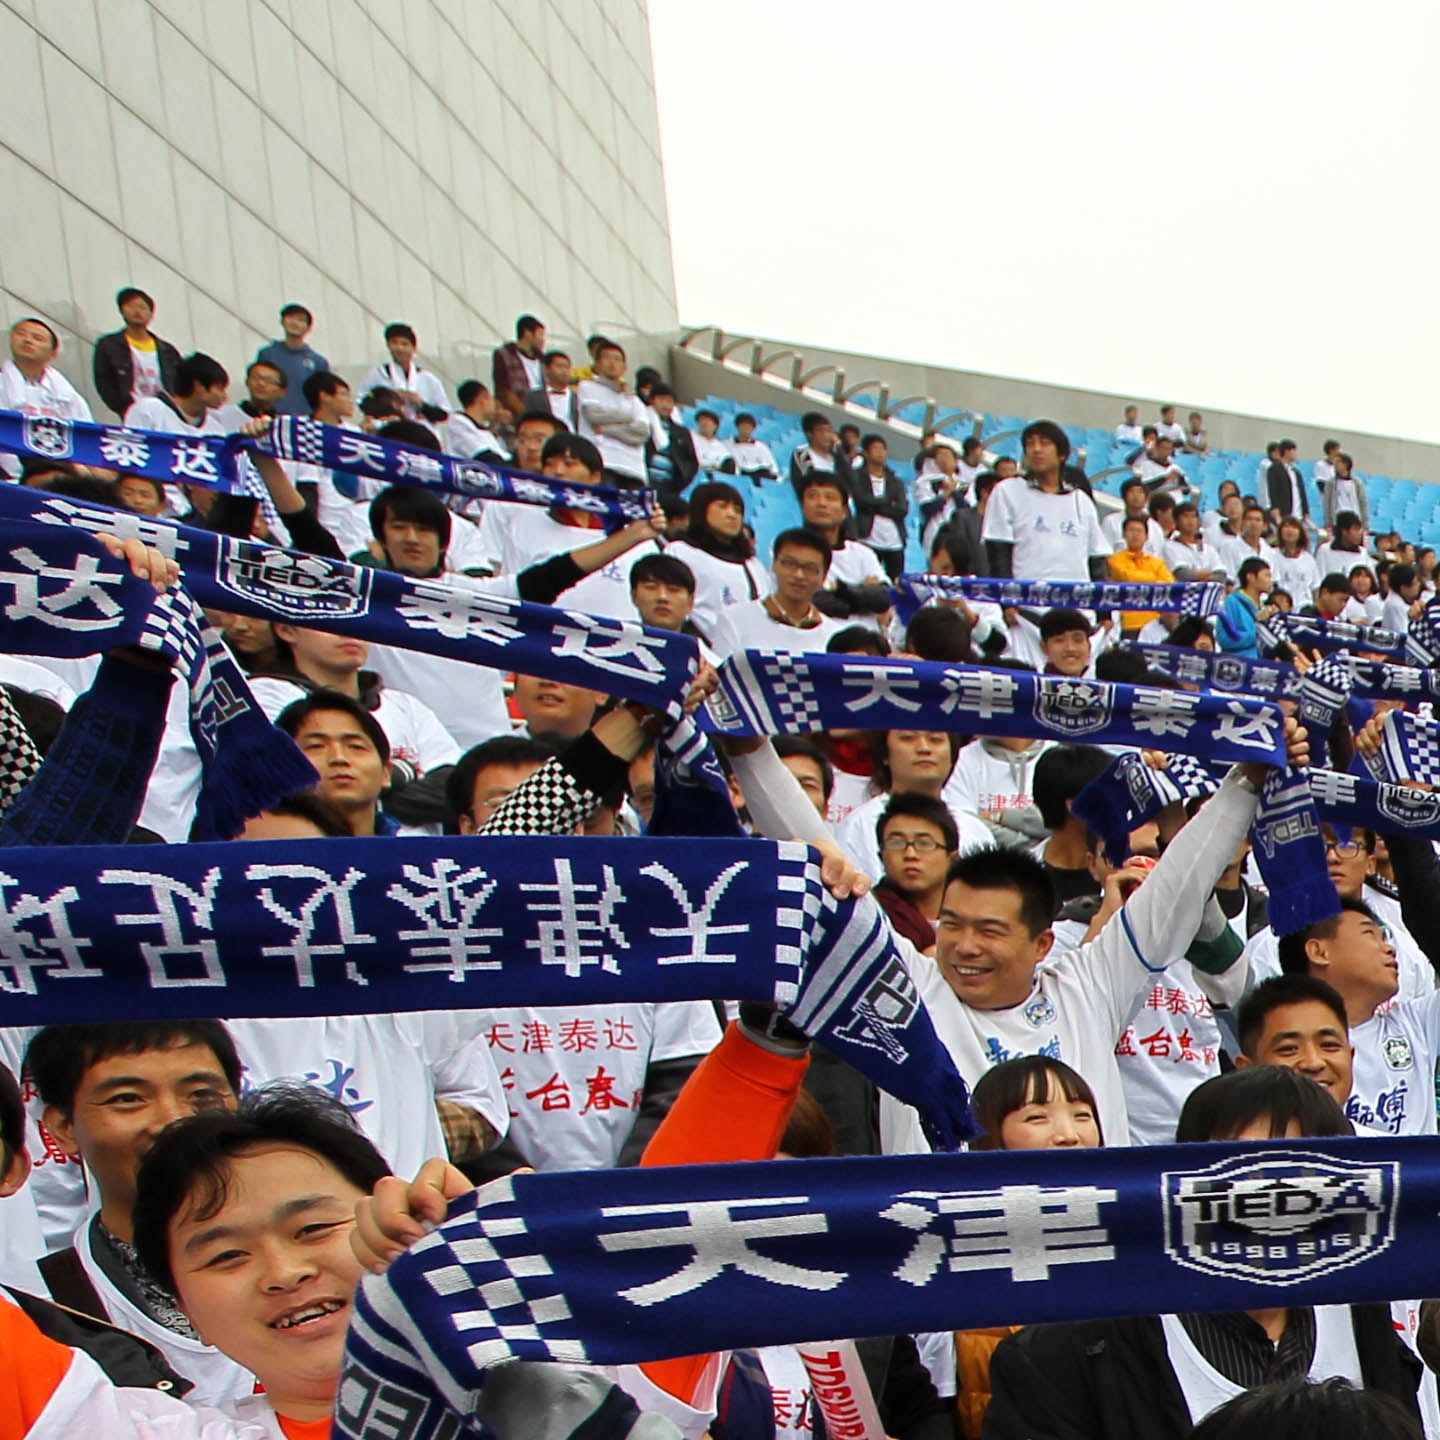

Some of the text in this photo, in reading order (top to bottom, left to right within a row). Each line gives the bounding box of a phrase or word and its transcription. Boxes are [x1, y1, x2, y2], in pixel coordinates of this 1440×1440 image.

[99, 427, 219, 482] 泰达
[339, 435, 443, 483] 天津
[0, 547, 124, 631] 达
[226, 557, 360, 598] TEDA
[396, 575, 667, 685] 泰达
[1145, 649, 1207, 680] 天津
[1337, 655, 1422, 692] 天津
[842, 664, 1280, 751] 天津 泰达
[1041, 692, 1105, 710] TEDA
[1386, 785, 1440, 805] TEDA
[1256, 811, 1319, 859] TEDA
[832, 953, 919, 1064] EDA
[485, 1018, 638, 1053] 天津泰达
[1180, 1178, 1386, 1219] TEDA
[598, 1184, 1117, 1307] 天津
